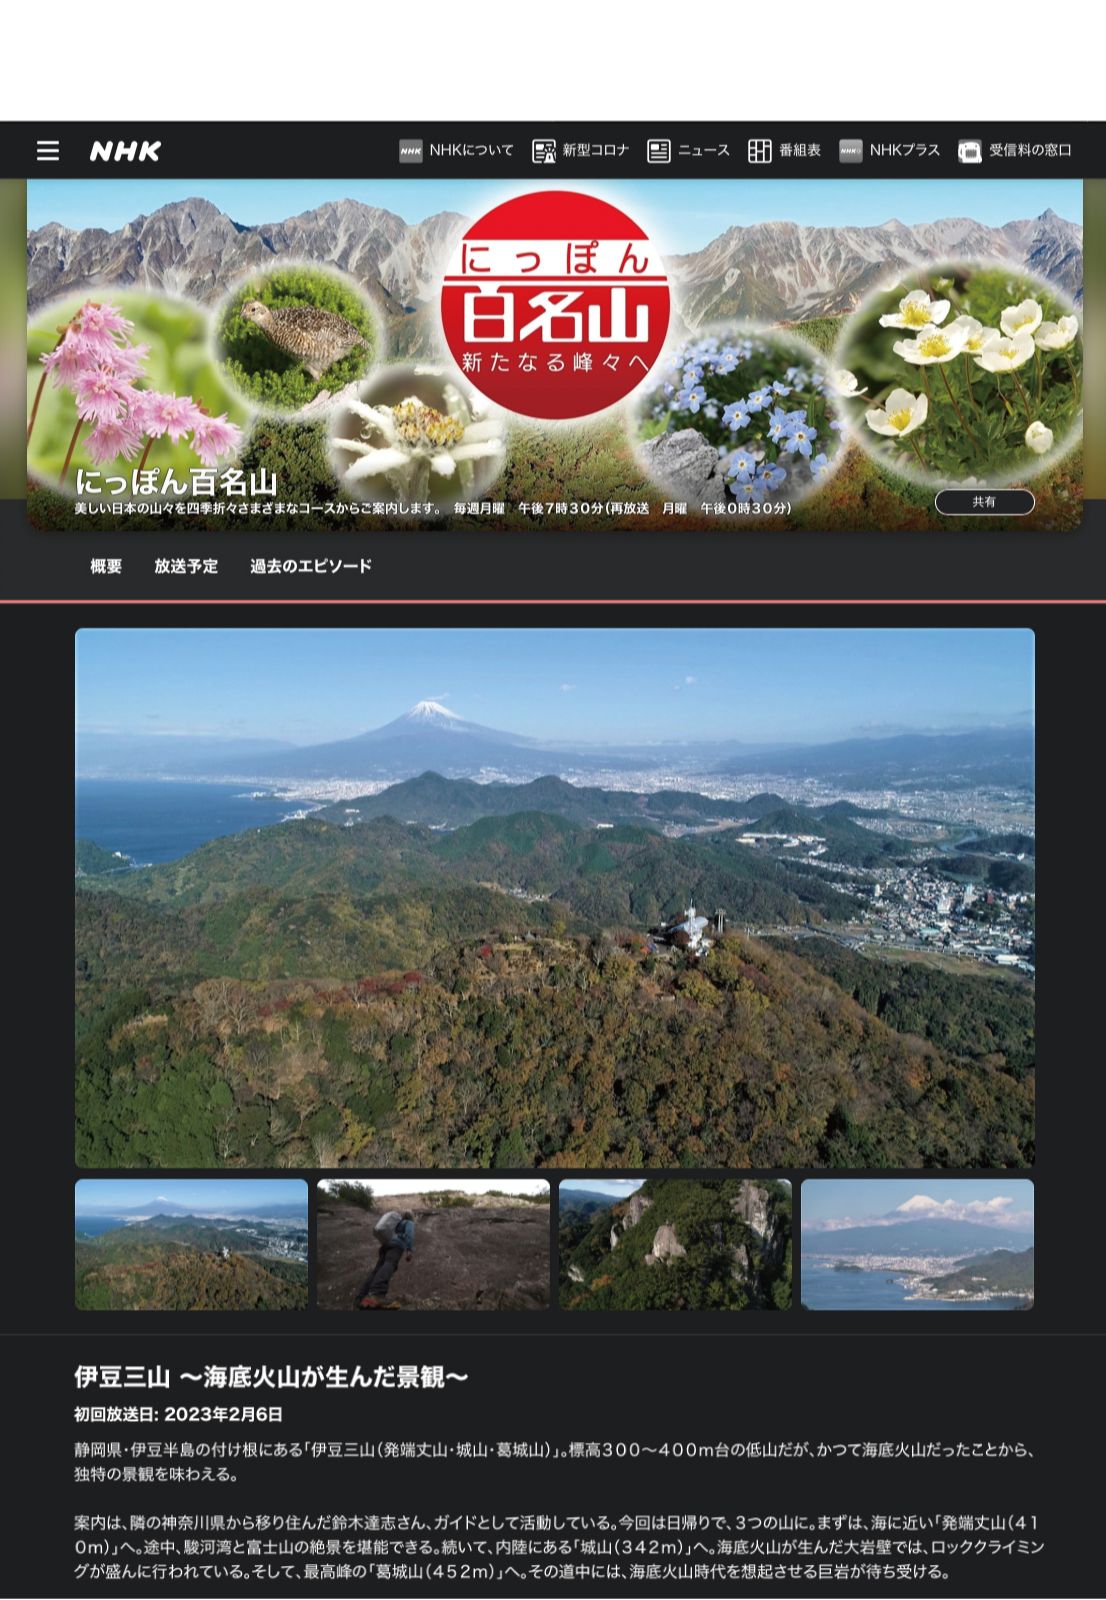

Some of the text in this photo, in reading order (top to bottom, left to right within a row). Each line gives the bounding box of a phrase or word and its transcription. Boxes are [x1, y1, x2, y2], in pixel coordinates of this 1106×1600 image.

[89, 140, 162, 162] NHK
[429, 143, 515, 158] NHKについて
[562, 142, 630, 158] 新型コロナ
[678, 143, 731, 158] ニュース
[779, 142, 821, 158] 番組表
[870, 142, 940, 157] NHKプラス
[989, 142, 1072, 158] 受信料の窓口
[461, 240, 649, 274] にっぽん
[463, 286, 649, 343] 百名山
[461, 351, 649, 373] 新たなる峰々へ
[76, 468, 278, 497] にっぽん百名山
[74, 501, 441, 516] 美しい日本の山々を四季折々さまざまなコースからご案内します。
[454, 501, 505, 515] 毎週月曜
[662, 502, 687, 515] 月曜
[972, 495, 997, 508] 共有
[90, 557, 123, 575] 概要
[154, 557, 219, 575] 放送予定
[250, 557, 372, 575] 過去のエピソード
[74, 1364, 170, 1390] 伊豆三山
[73, 1405, 283, 1424] 初回放送日: 2023年2月6日
[74, 1466, 238, 1483] 独特の景観を味わえる。
